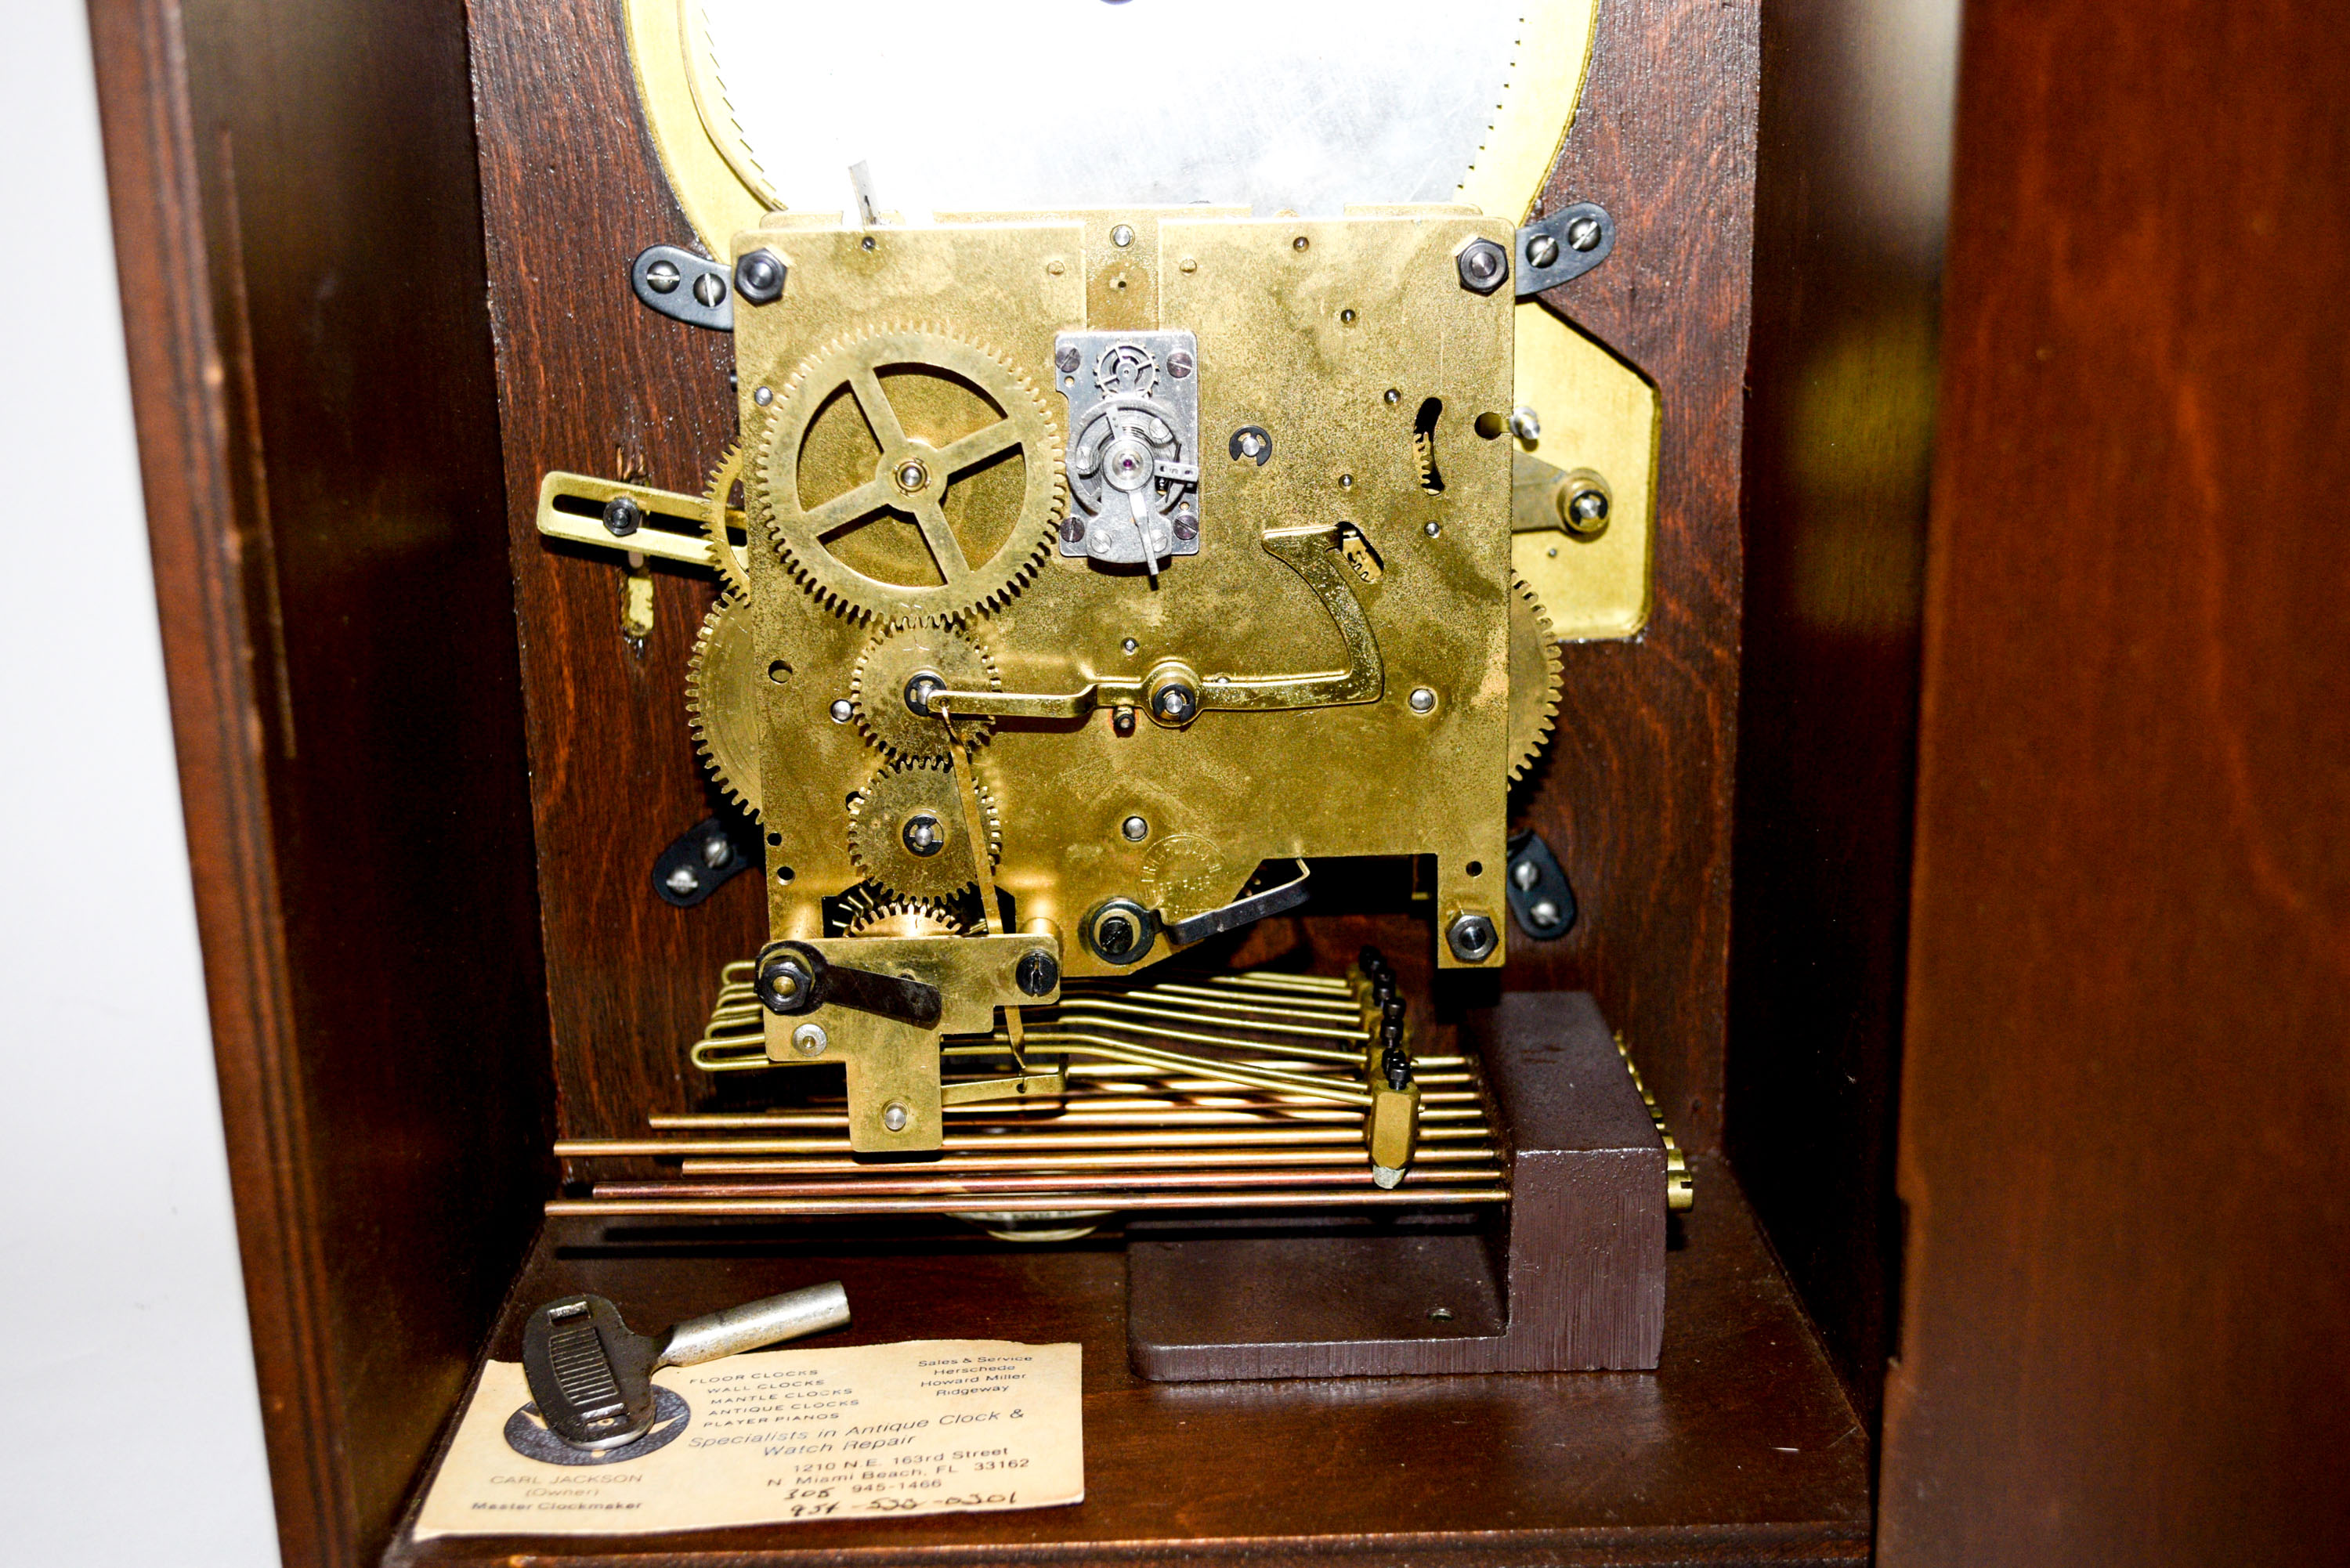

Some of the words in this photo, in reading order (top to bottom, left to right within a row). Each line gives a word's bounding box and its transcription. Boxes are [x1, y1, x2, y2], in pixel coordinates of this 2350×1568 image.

[689, 1375, 745, 1384] FLOOR
[751, 1369, 819, 1379] CLOCKS
[934, 1364, 1015, 1375] Herschede
[707, 1386, 751, 1394] WALL
[757, 1379, 825, 1389] CLOCKS
[920, 1376, 979, 1387] Howard
[710, 1393, 778, 1404] MANTLE
[784, 1388, 852, 1398] CLOCKS
[936, 1385, 1009, 1396] Ridgeway
[708, 1404, 784, 1416] ANTIQUE
[791, 1400, 859, 1410] CLOCKS
[689, 1430, 808, 1448] Specialists
[818, 1428, 837, 1438] in
[844, 1418, 929, 1436] Antique
[938, 1410, 1001, 1425] Clock
[1009, 1408, 1025, 1418] &
[703, 1417, 768, 1428] PLAYER
[775, 1413, 840, 1422] PIANOS
[762, 1442, 833, 1458] Watch
[843, 1435, 916, 1451] Repair
[794, 1462, 836, 1472] 1210
[893, 1453, 945, 1465] 163rd
[952, 1447, 1009, 1459] Street
[796, 1474, 853, 1485] Miami
[936, 1465, 959, 1475] FL
[974, 1458, 1030, 1472] 33162
[490, 1475, 543, 1485] CARL
[549, 1475, 644, 1485] JACKSON
[851, 1478, 942, 1493] 945-1466
[525, 1487, 600, 1498] (Owner)
[471, 1502, 533, 1511] Master
[537, 1502, 644, 1511] Clockmaker
